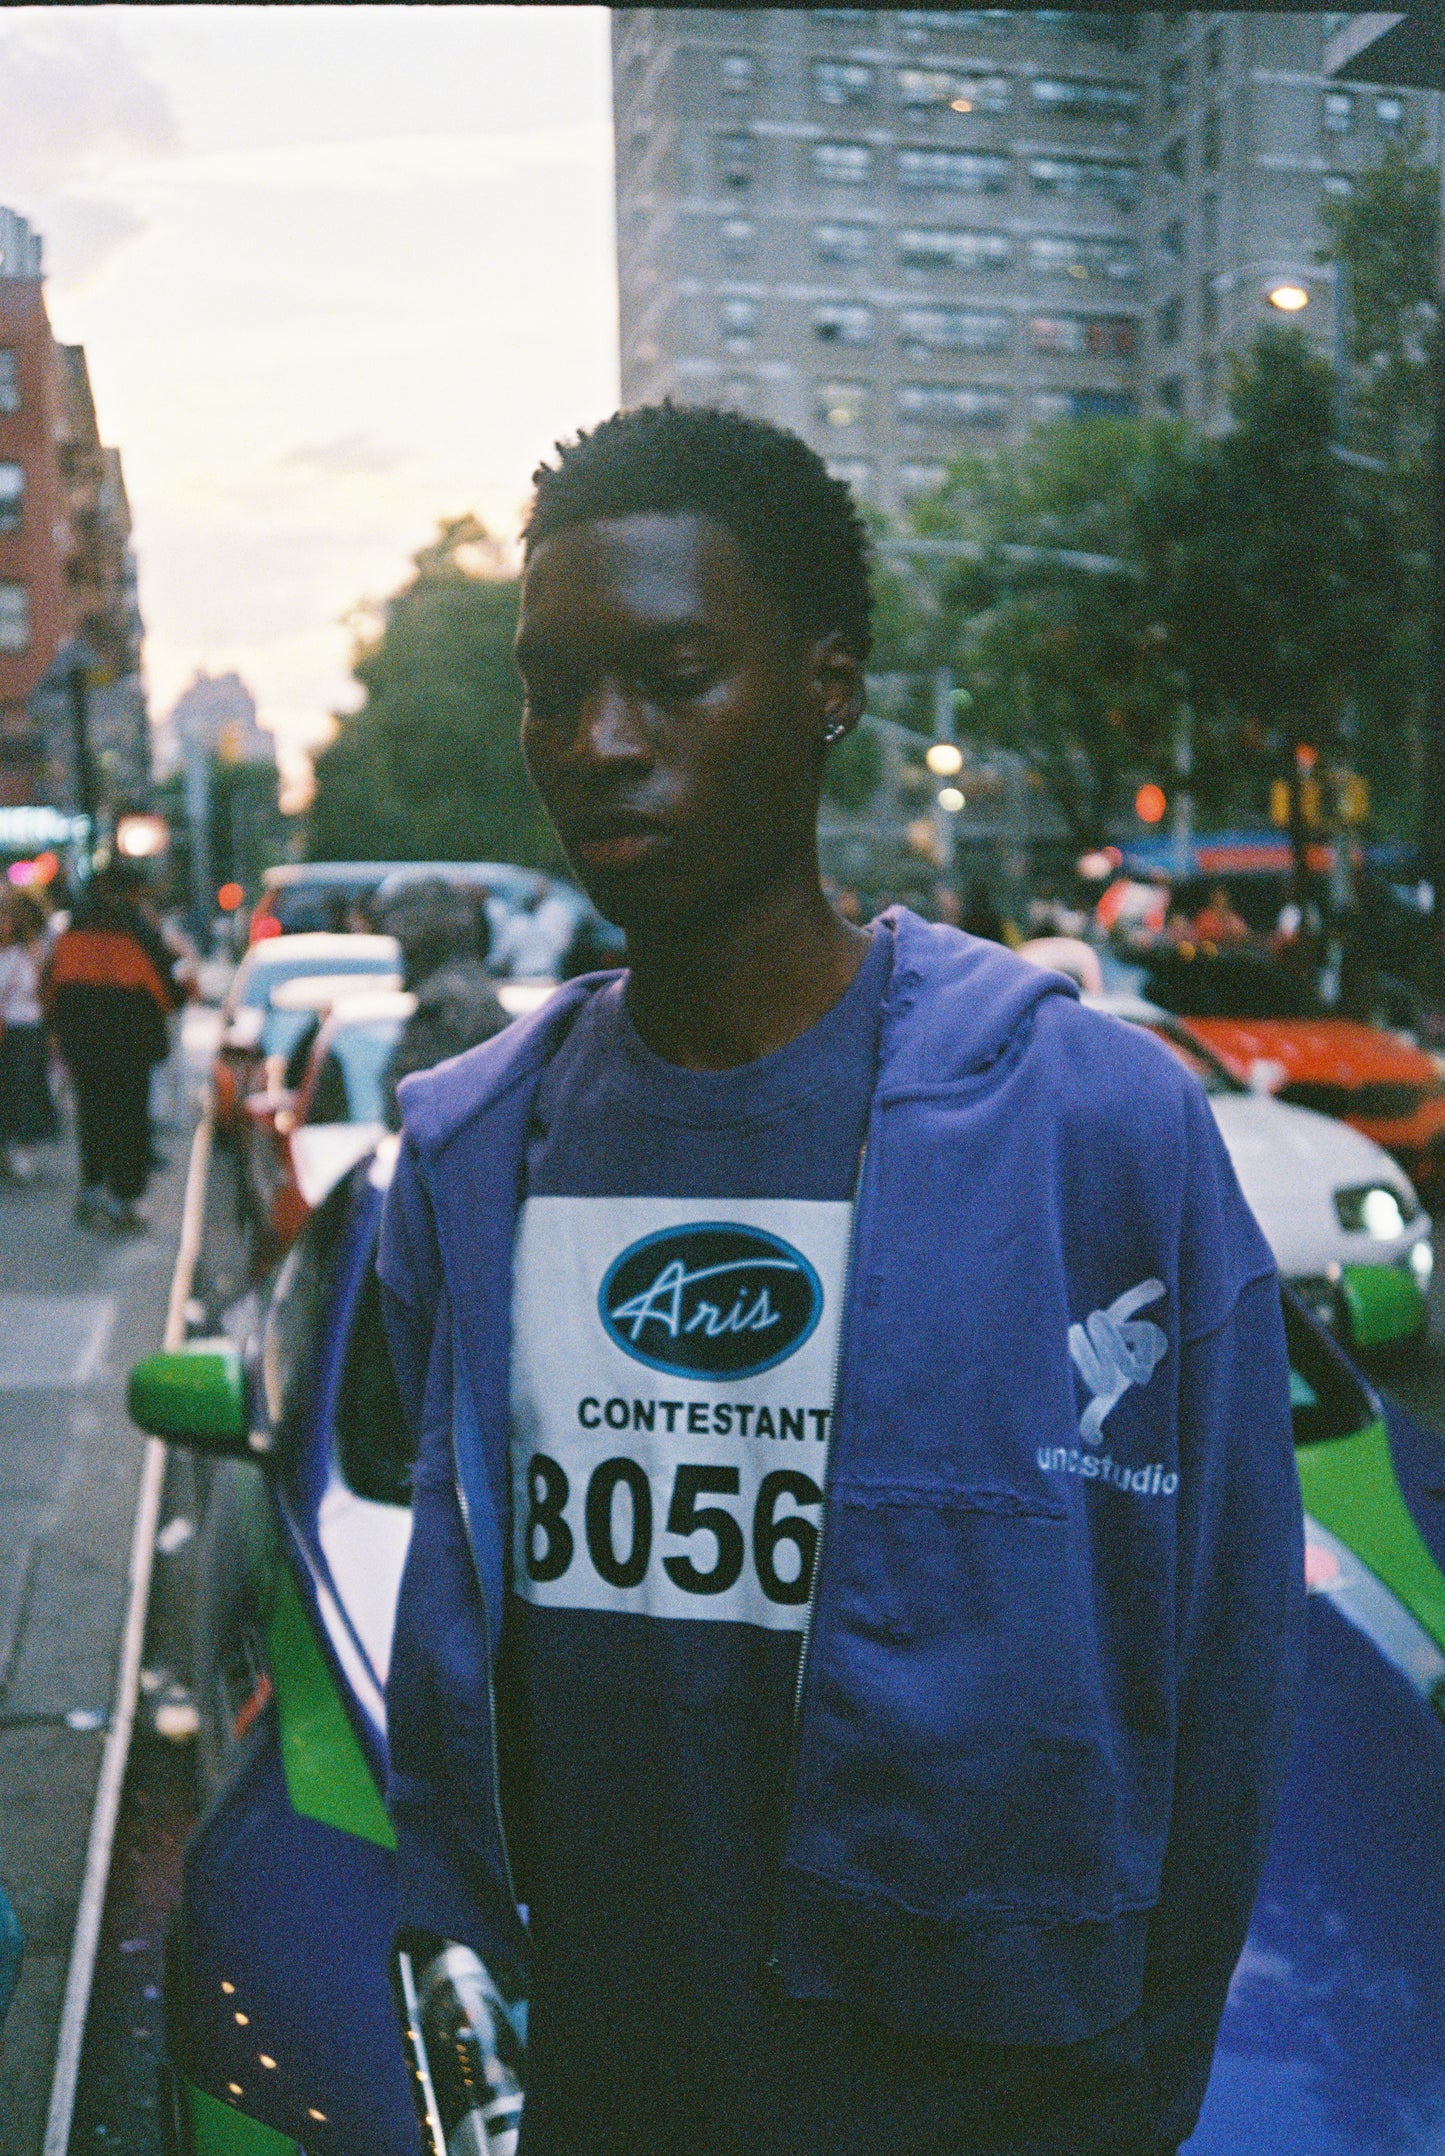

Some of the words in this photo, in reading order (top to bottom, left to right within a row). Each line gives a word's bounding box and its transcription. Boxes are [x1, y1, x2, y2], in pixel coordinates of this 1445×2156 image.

[612, 1258, 798, 1340] Aris
[578, 1396, 832, 1442] CONTESTANT
[526, 1453, 825, 1606] 8056
